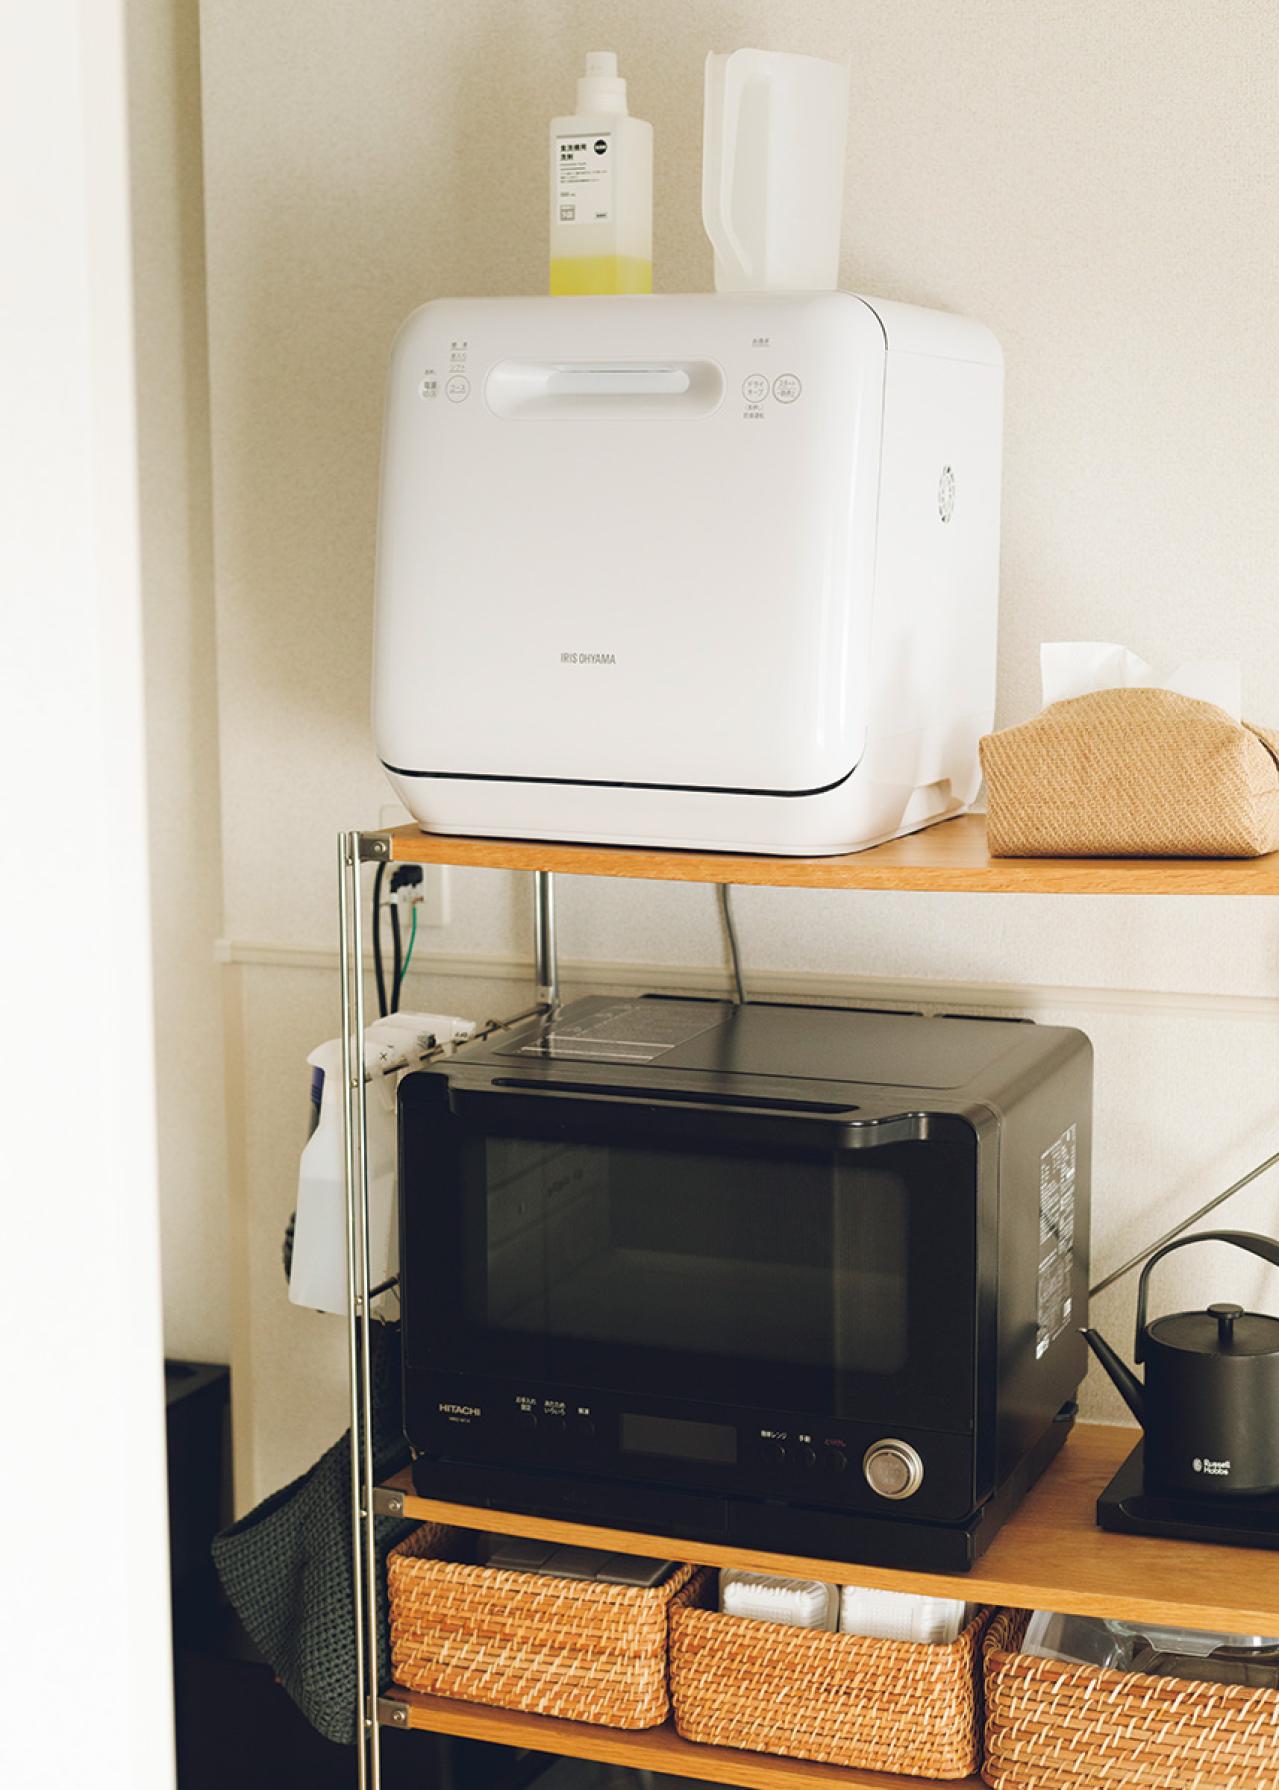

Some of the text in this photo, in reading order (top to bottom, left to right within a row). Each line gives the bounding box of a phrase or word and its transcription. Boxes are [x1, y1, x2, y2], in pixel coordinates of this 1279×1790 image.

[560, 652, 617, 664] IRIS OHYAMA
[439, 1403, 481, 1416] HITACHI
